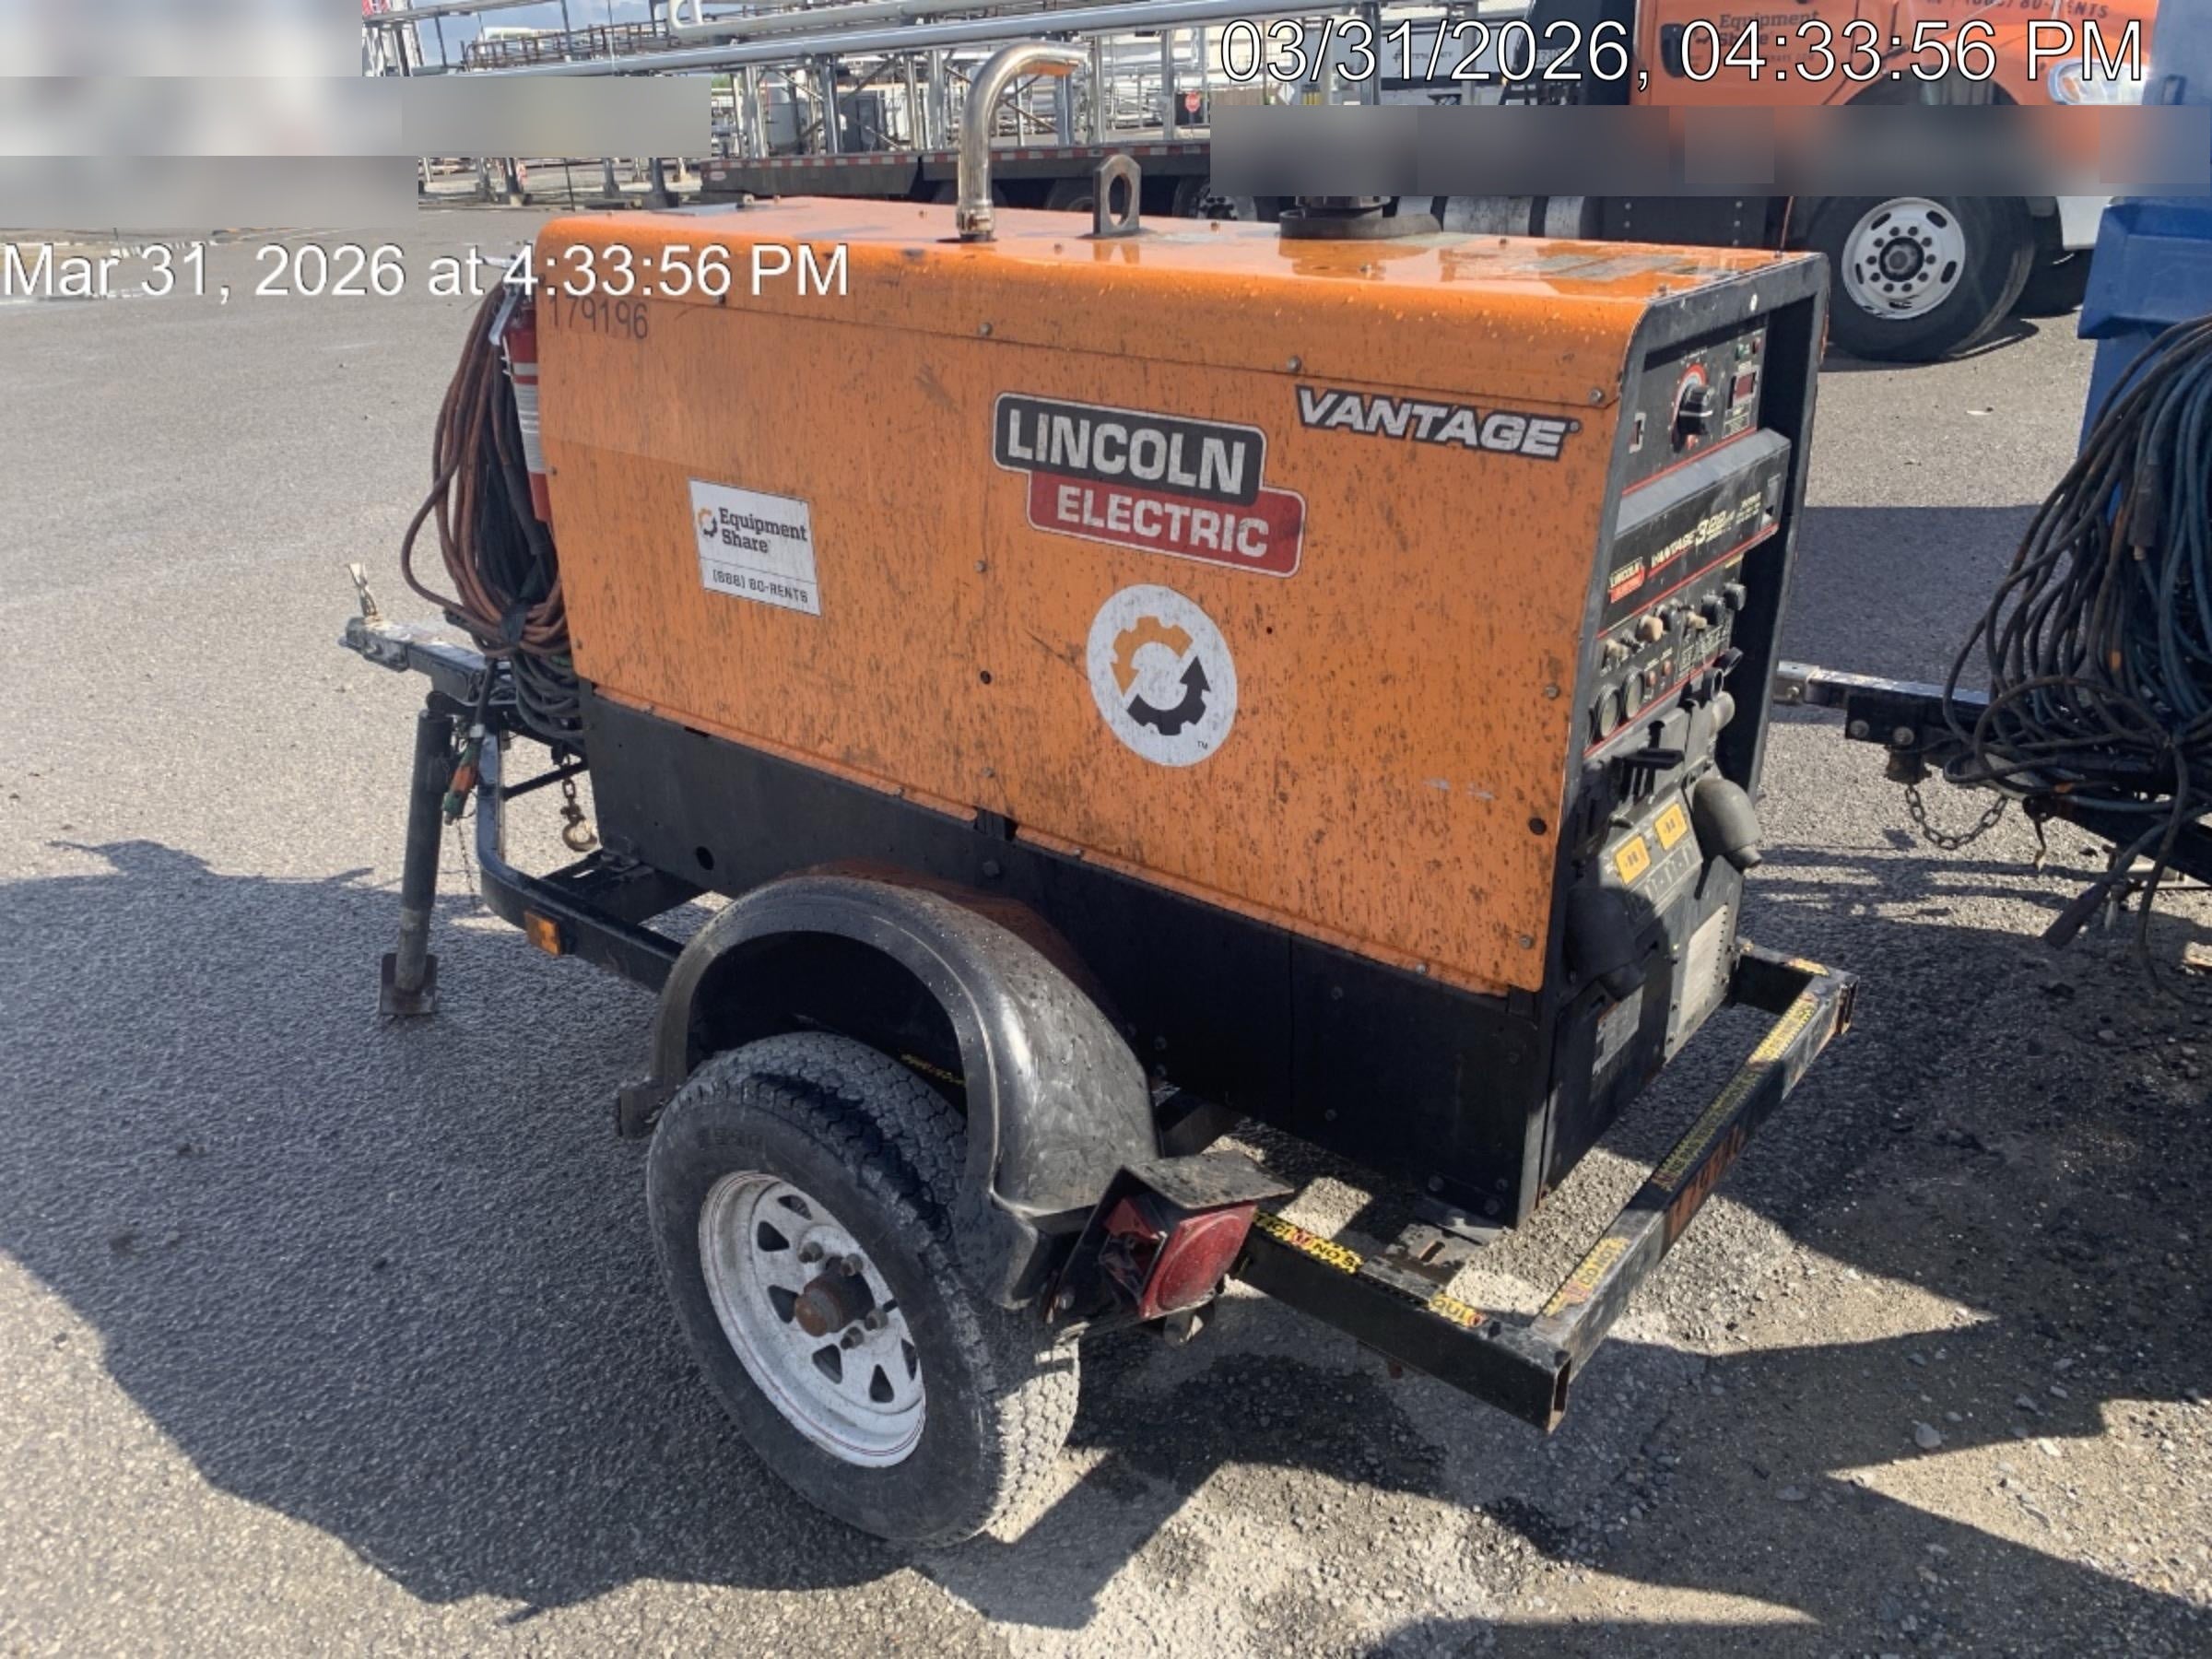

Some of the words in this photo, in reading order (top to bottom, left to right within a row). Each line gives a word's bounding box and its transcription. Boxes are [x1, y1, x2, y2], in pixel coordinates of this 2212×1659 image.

[548, 294, 650, 340] 179196
[1006, 408, 1247, 496] LINCOLN
[718, 506, 808, 542] Equipment
[721, 528, 770, 554] Share
[1056, 483, 1270, 559] ELECTRIC
